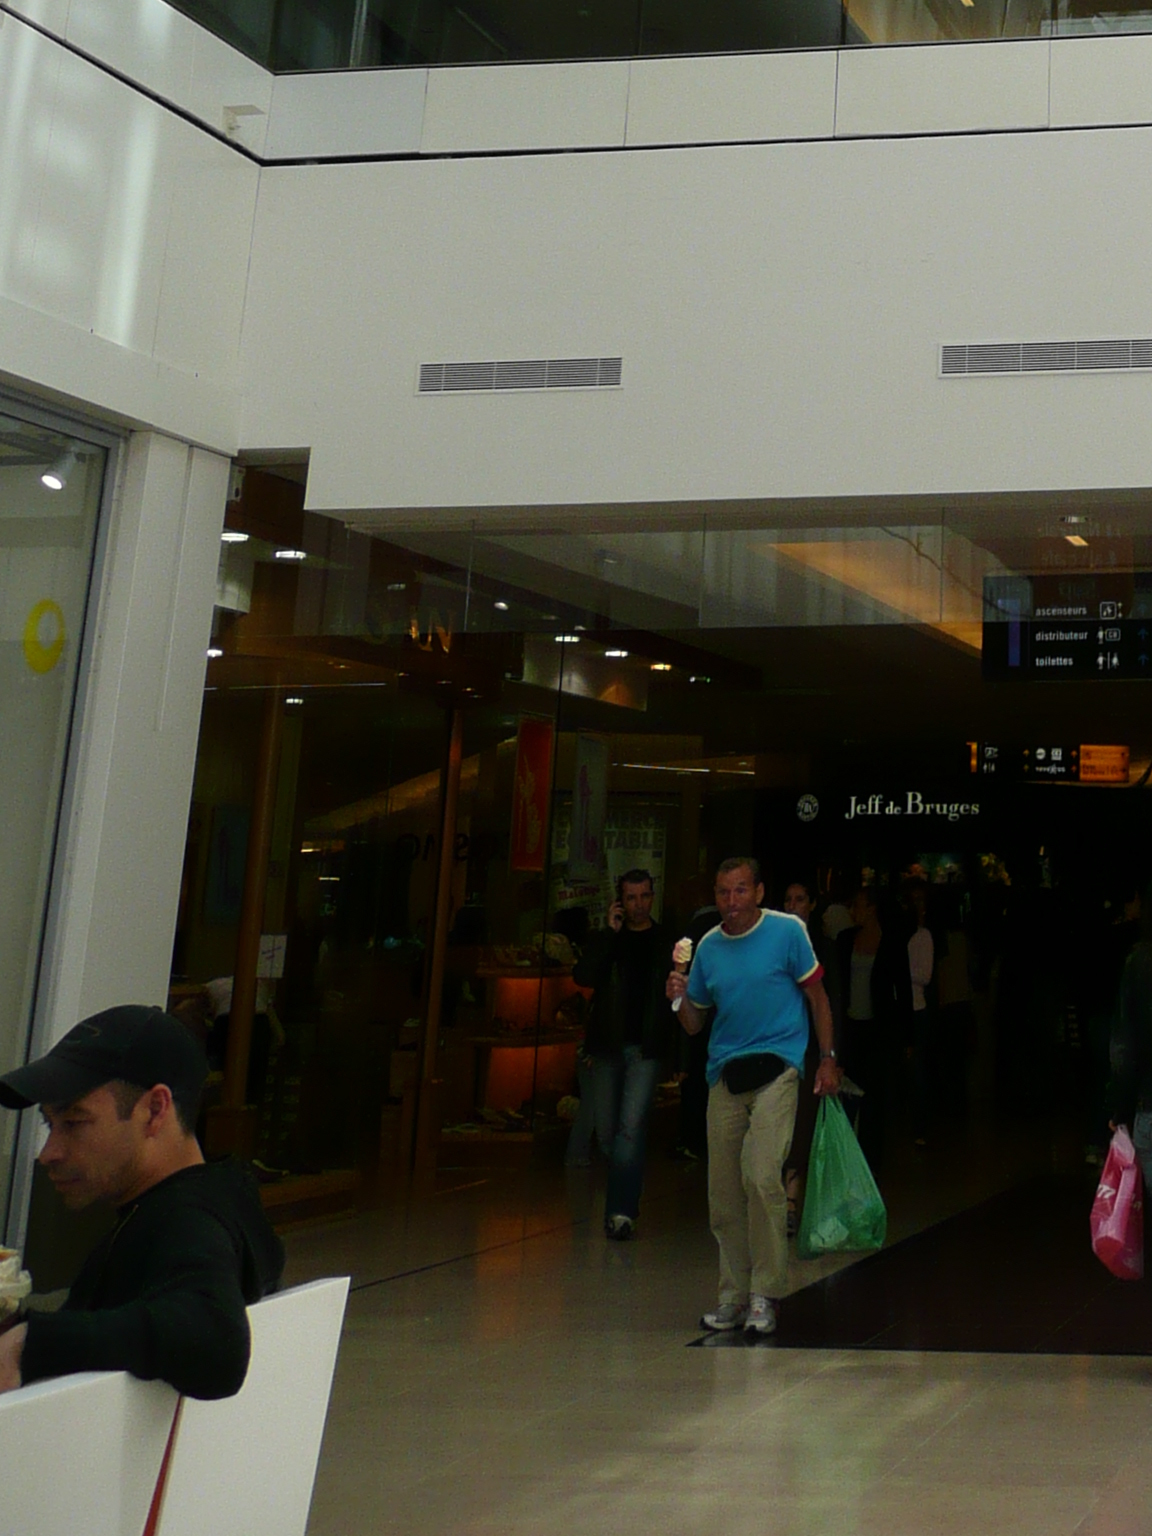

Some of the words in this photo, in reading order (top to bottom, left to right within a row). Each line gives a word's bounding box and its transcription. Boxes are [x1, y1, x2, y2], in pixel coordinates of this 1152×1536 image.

[1035, 605, 1088, 617] ascenseurs
[1035, 629, 1089, 643] distributeur
[1035, 655, 1075, 667] toilettes
[844, 793, 884, 821] Jeff
[885, 801, 903, 815] de
[903, 790, 981, 822] Bruges
